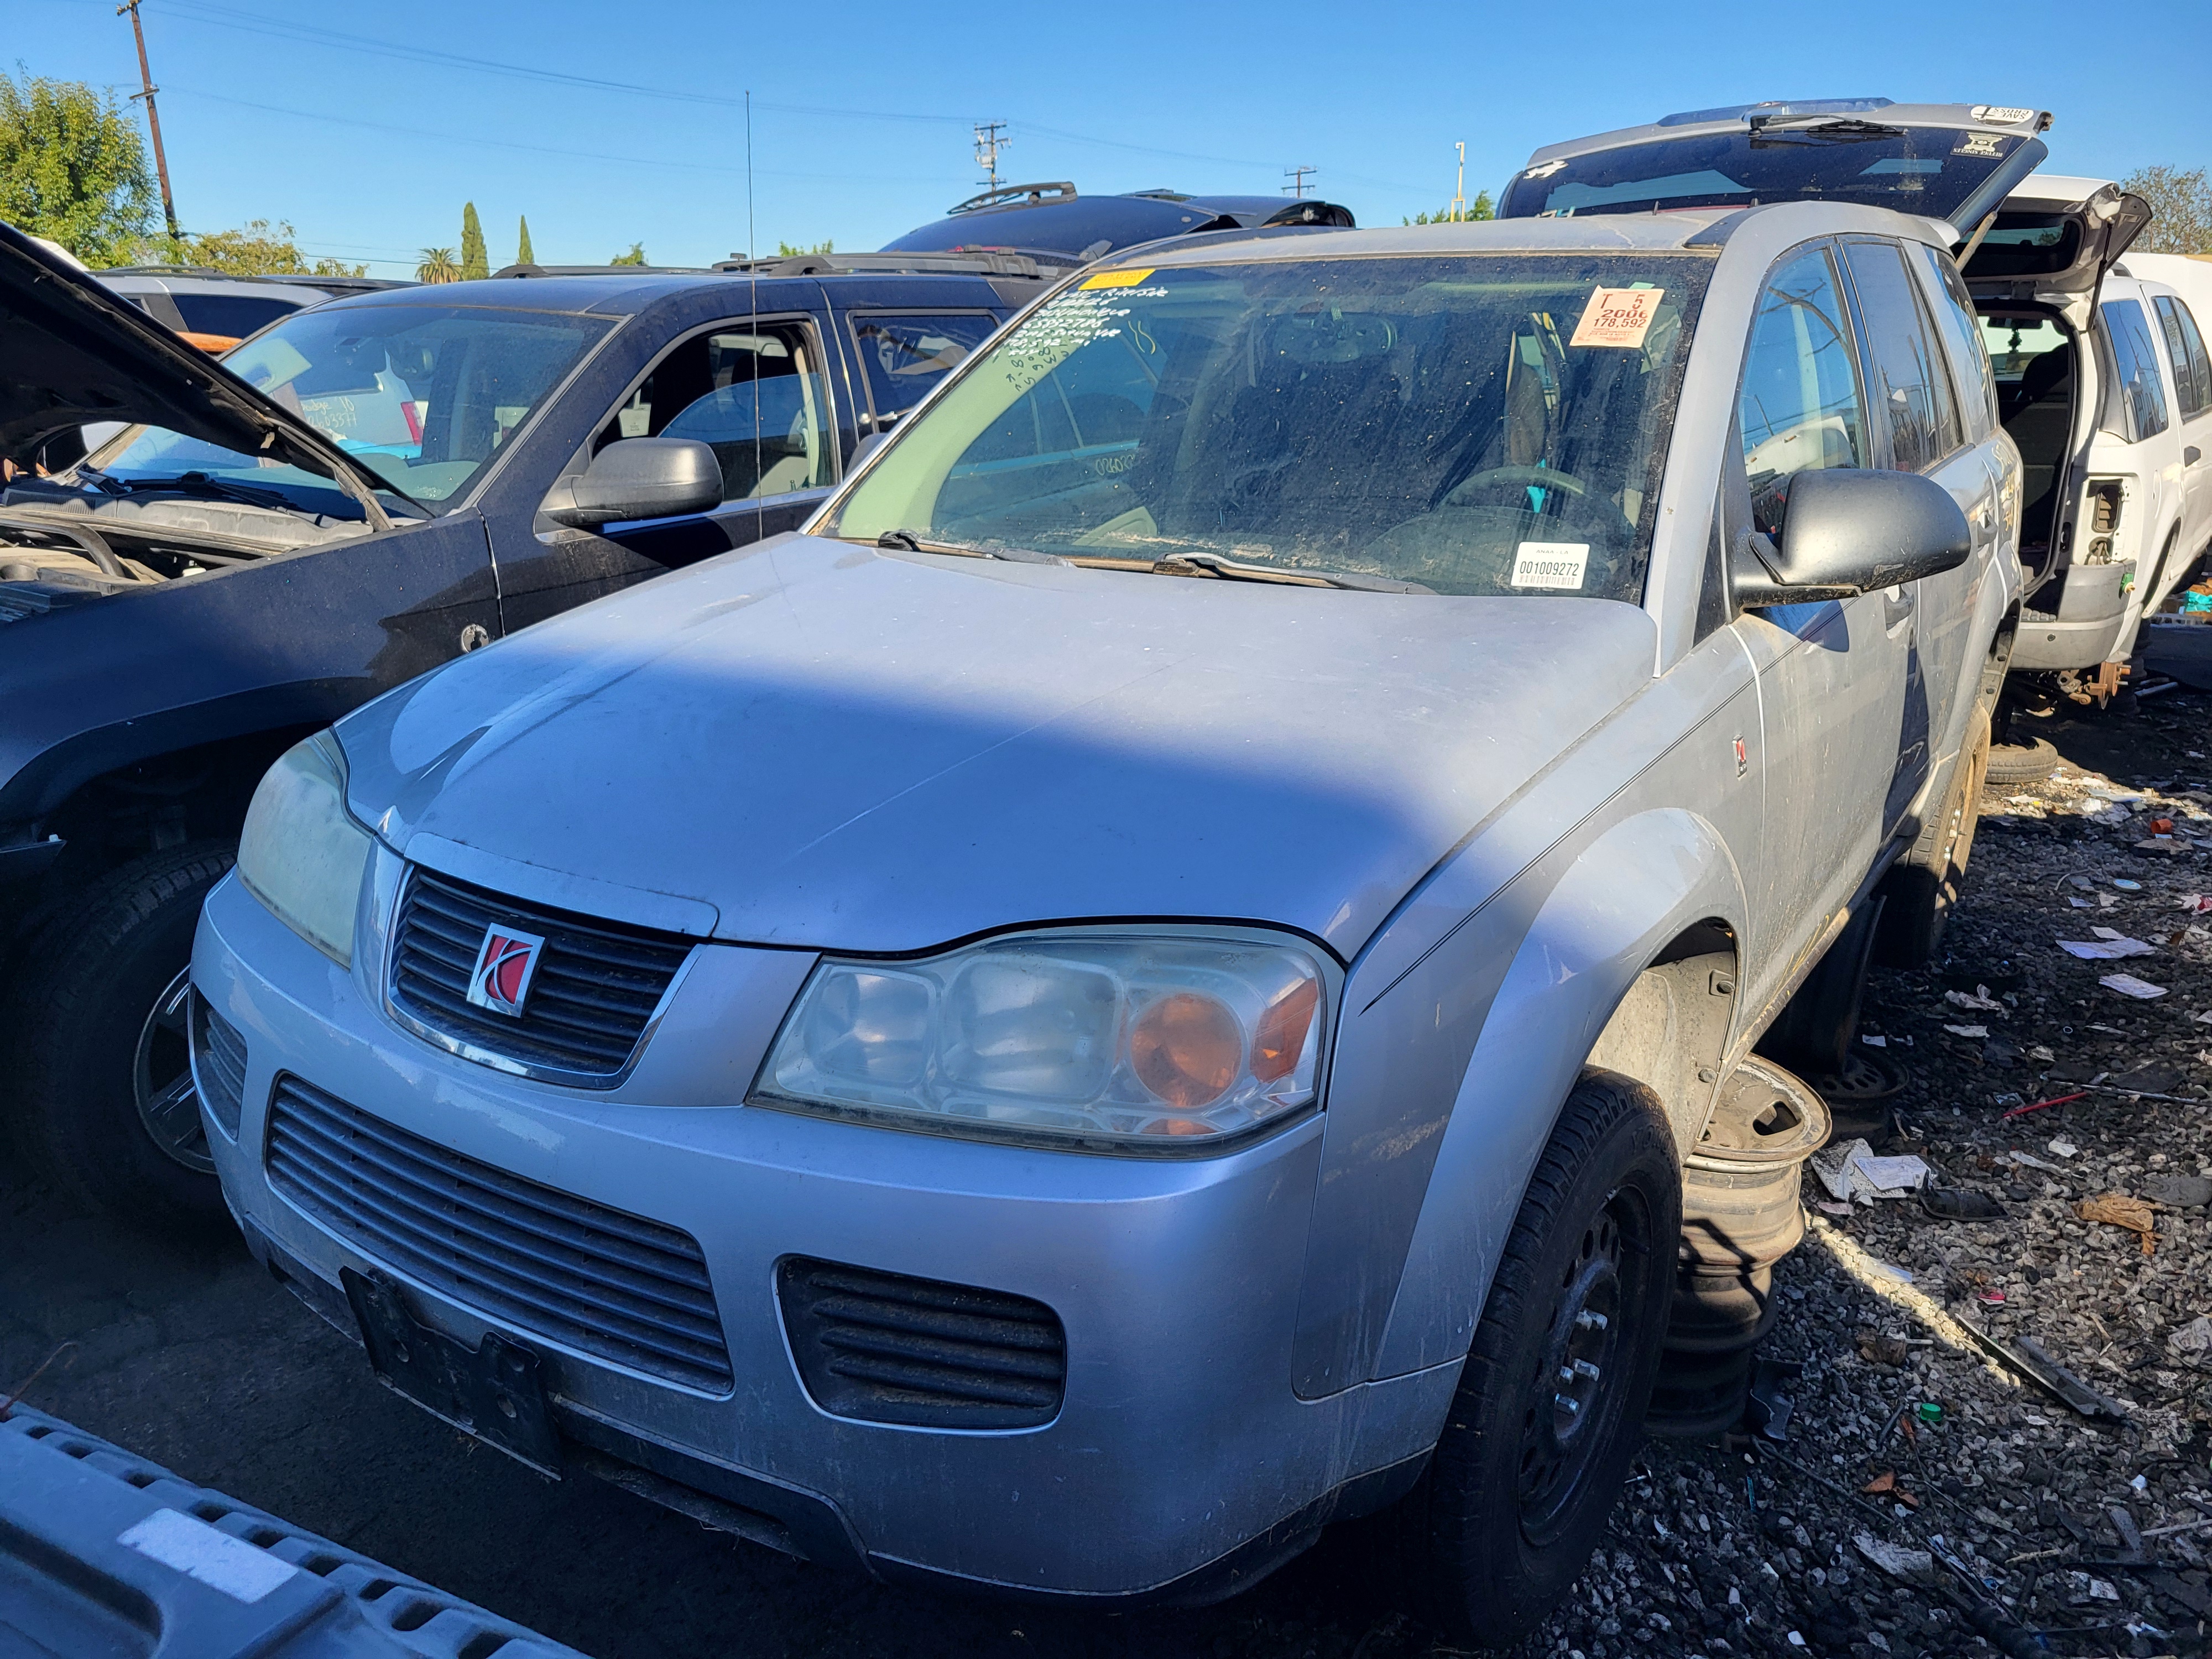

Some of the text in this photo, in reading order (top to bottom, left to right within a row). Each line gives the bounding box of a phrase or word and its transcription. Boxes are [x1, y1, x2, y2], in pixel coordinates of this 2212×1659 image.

[1993, 107, 2030, 116] CROSS
[1600, 294, 1646, 310] T 5
[1600, 309, 1648, 319] 2006
[1593, 318, 1647, 328] 178,592
[1520, 561, 1579, 576] 001009272
